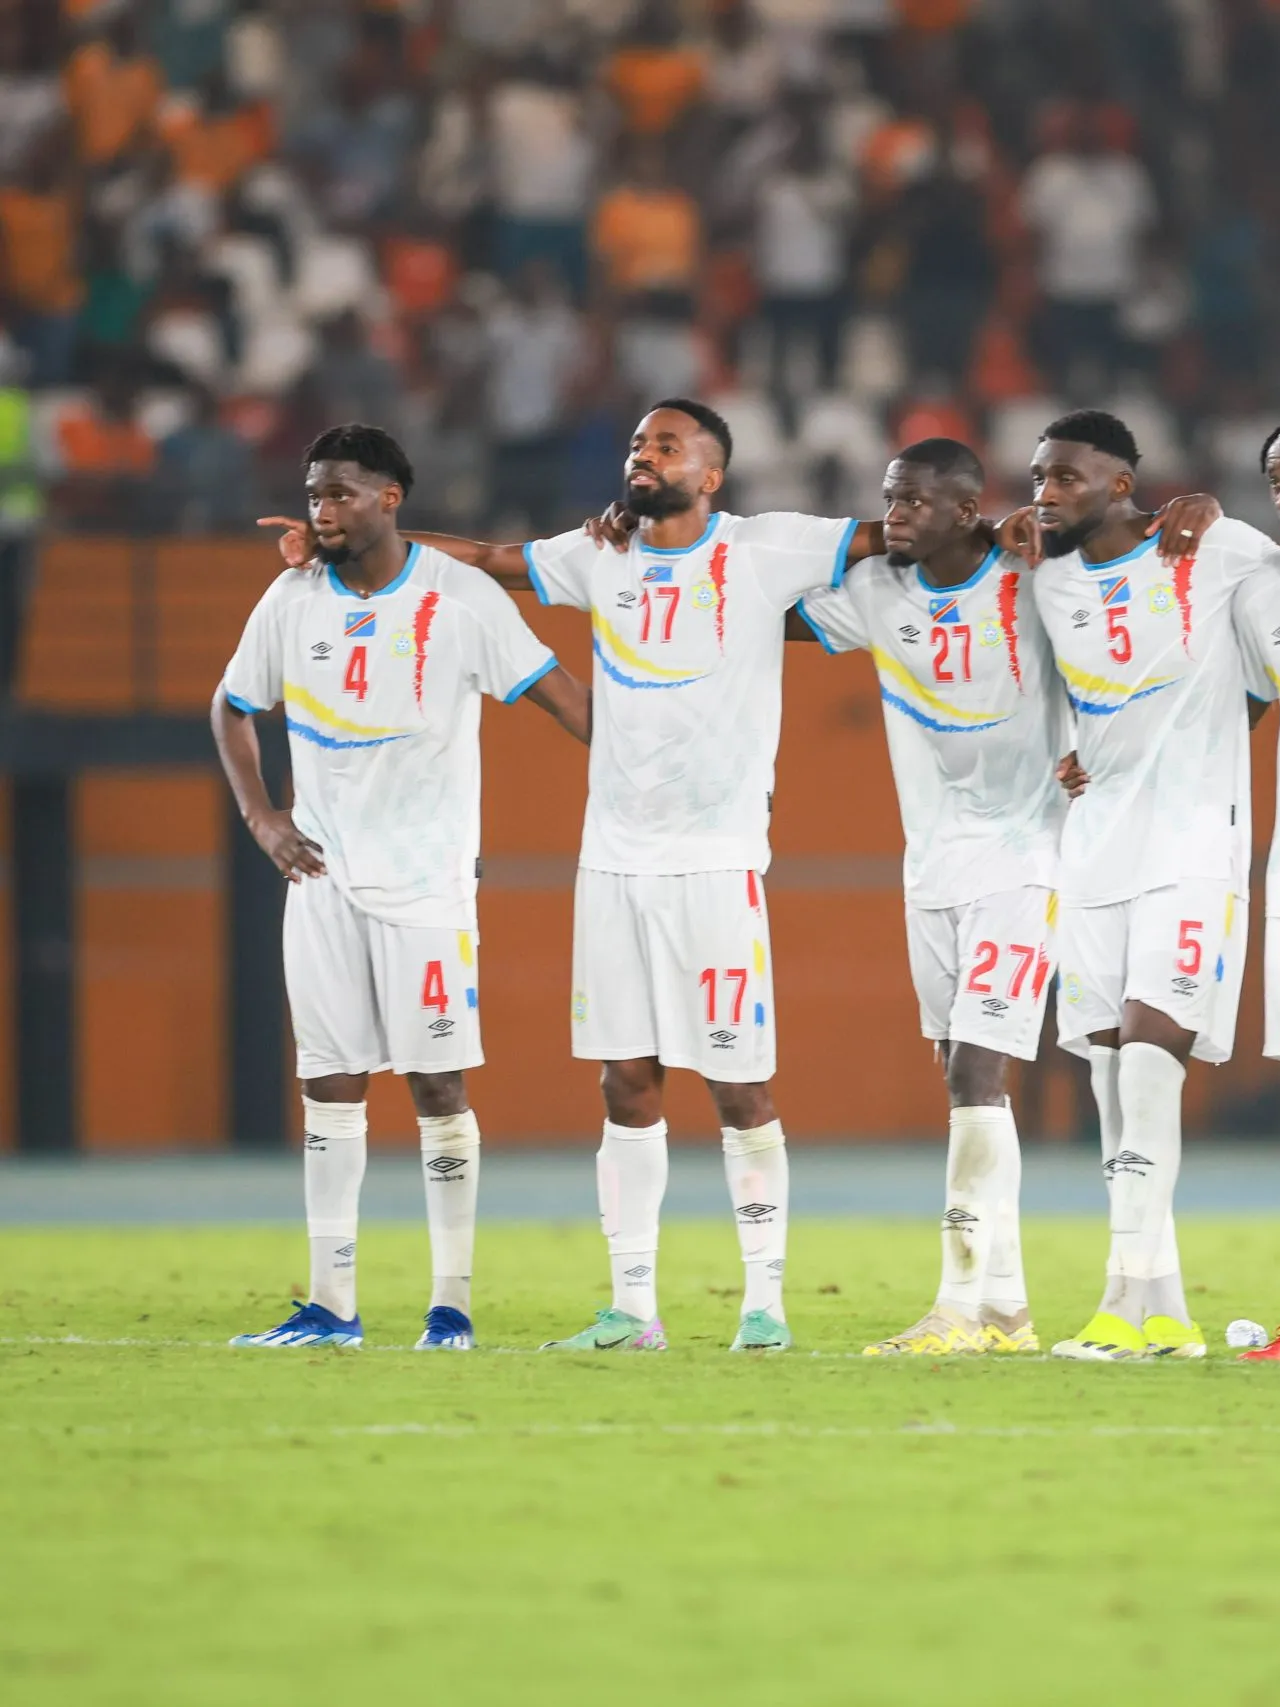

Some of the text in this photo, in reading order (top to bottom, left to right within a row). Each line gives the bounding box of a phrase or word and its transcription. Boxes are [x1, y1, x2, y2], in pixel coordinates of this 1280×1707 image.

[640, 587, 681, 644] 17
[1106, 606, 1132, 665] 5
[342, 645, 368, 702] 4
[930, 624, 973, 682] 27
[964, 940, 1036, 1001] 27
[1175, 919, 1204, 977] 5
[421, 960, 449, 1017] 4
[698, 968, 748, 1026] 17
